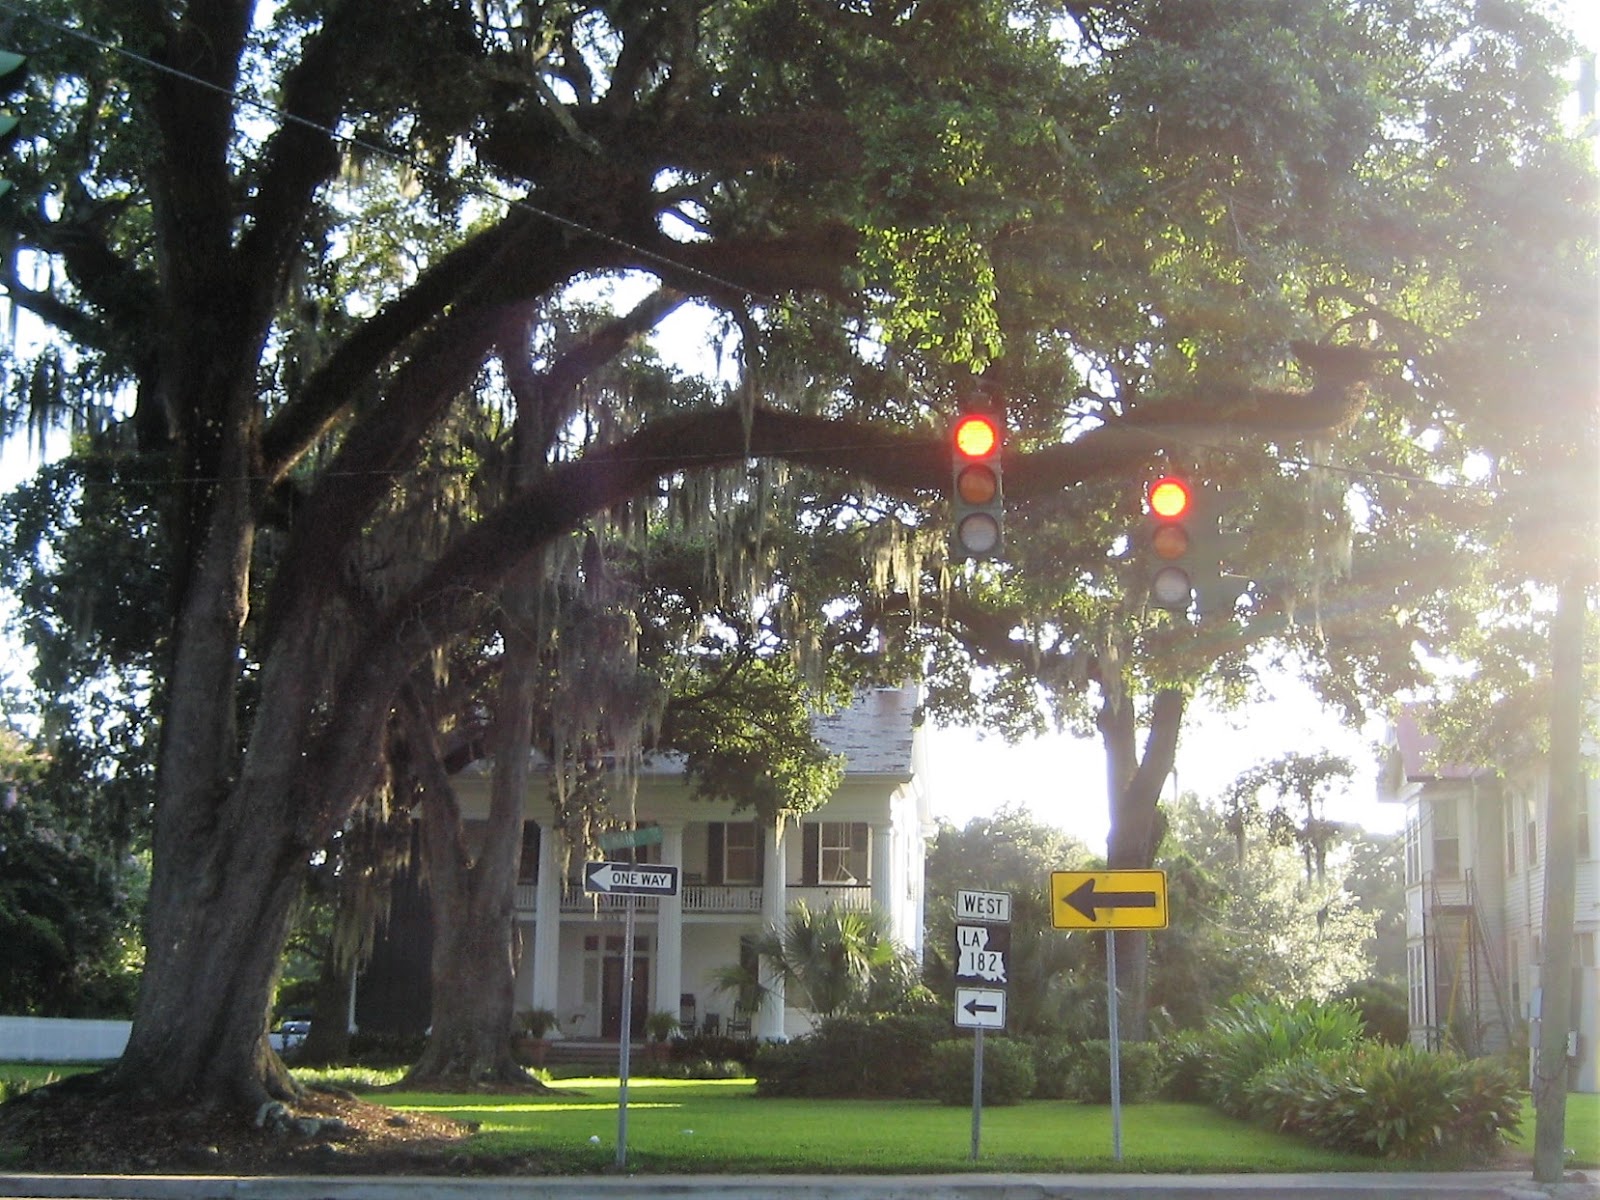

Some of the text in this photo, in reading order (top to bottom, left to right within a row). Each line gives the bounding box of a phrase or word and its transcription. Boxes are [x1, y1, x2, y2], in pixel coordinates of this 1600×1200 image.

[612, 872, 667, 886] ONE WAY
[964, 894, 1003, 915] WEST
[962, 930, 980, 947] LA
[971, 953, 997, 972] 182
